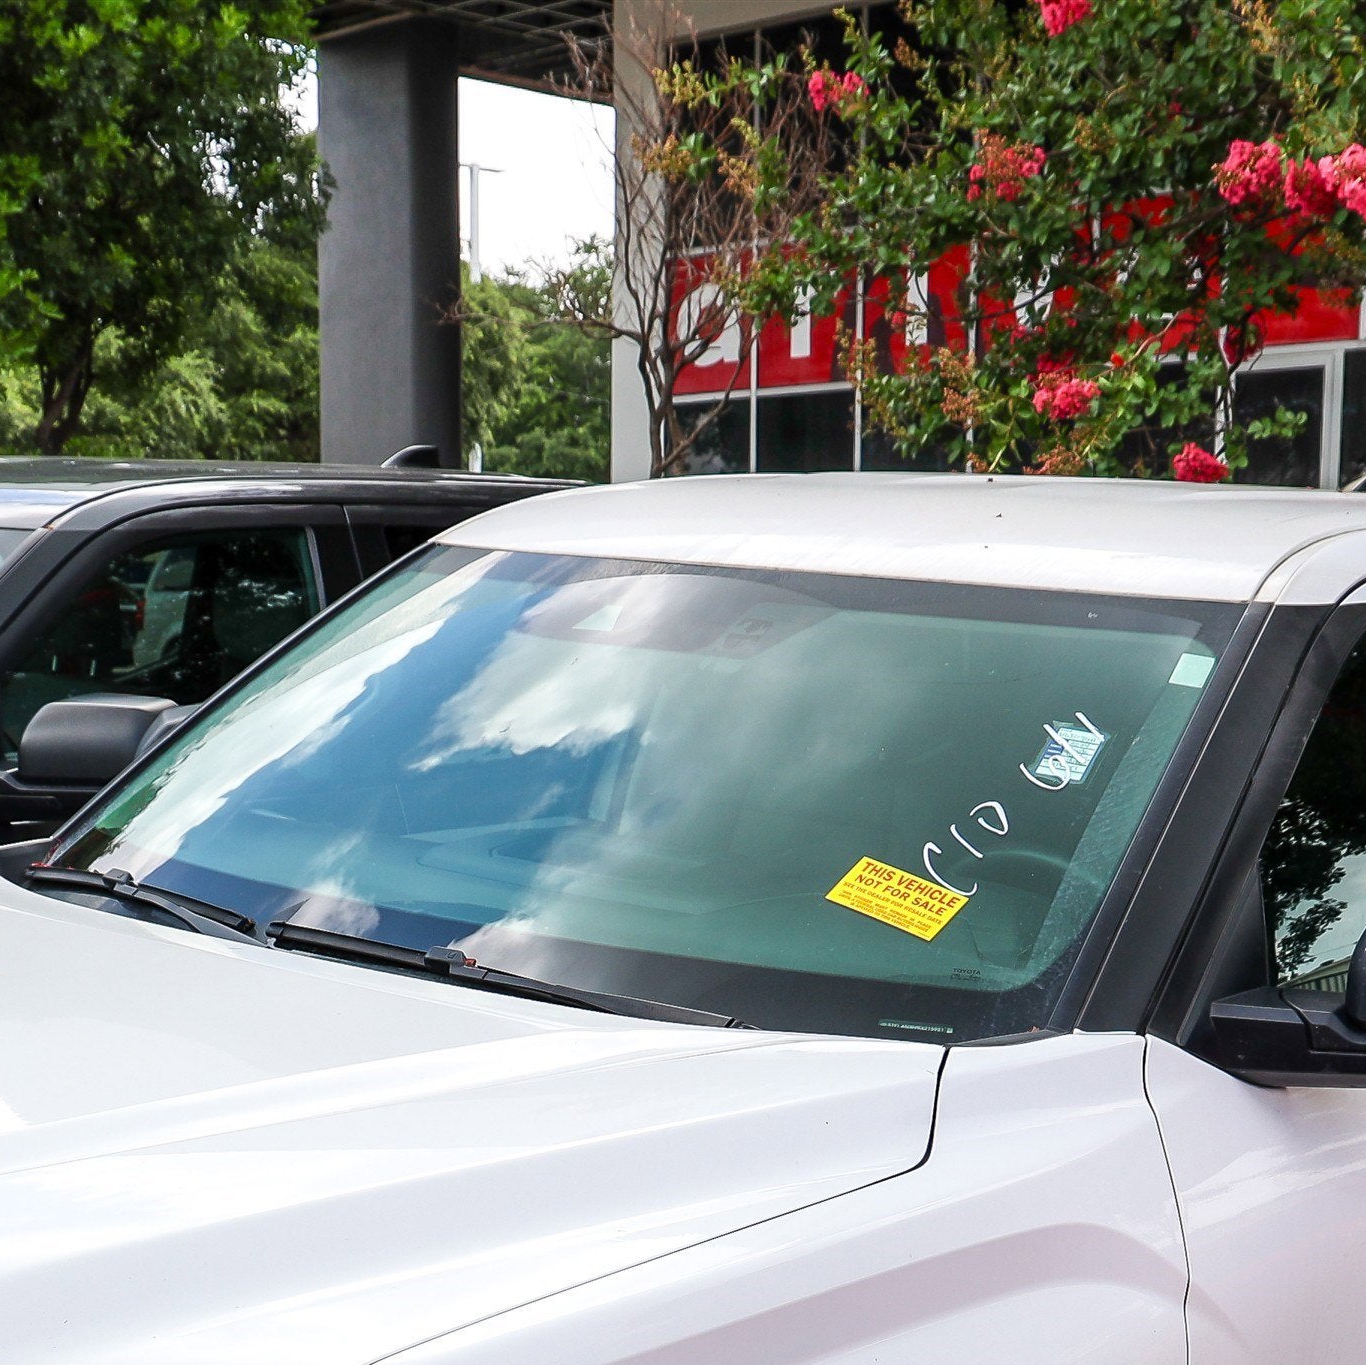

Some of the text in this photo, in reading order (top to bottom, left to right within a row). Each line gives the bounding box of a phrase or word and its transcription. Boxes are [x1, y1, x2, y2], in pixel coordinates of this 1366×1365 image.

[854, 874, 947, 916] NOT FOR SALE
[861, 861, 961, 908] THIS VEHICLE
